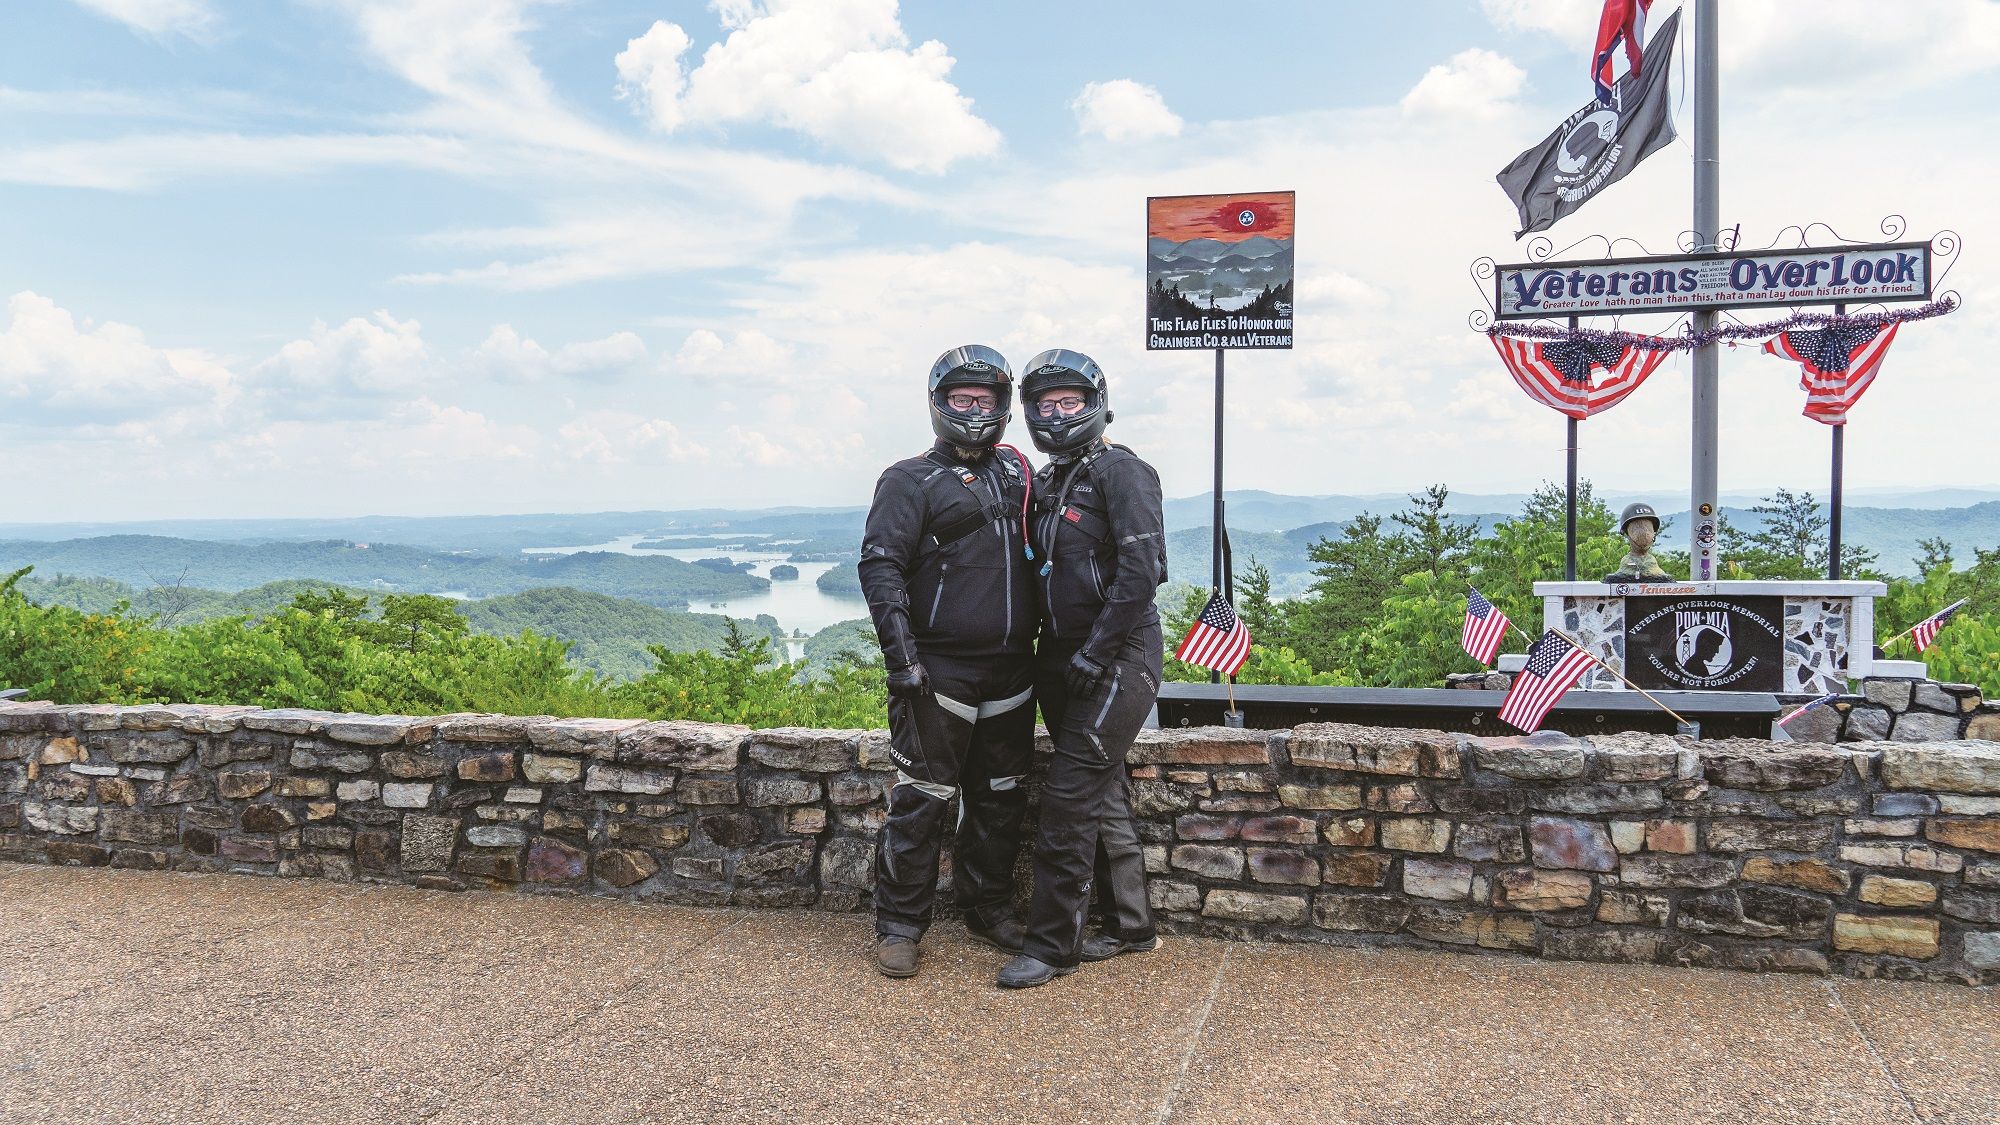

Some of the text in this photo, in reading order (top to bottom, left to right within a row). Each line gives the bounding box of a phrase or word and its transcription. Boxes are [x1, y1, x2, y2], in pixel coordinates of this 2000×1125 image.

[1507, 267, 1700, 312] Veterans
[1542, 300, 1578, 310] Greater
[1579, 299, 1600, 308] Love
[1605, 298, 1626, 306] hath
[1629, 298, 1641, 306] no
[1643, 297, 1663, 305] man
[1667, 294, 1689, 304] than
[1691, 293, 1714, 304] this,
[1715, 290, 1737, 300] that
[1738, 292, 1744, 300] a
[1746, 292, 1767, 300] man
[1789, 287, 1813, 297] down
[1816, 286, 1830, 296] his
[1852, 284, 1869, 294] for
[1880, 284, 1913, 294] friend
[1150, 316, 1292, 332] THIS FLAG FLIES TO HONOR OUR
[1150, 334, 1202, 348] GRAINGER
[1247, 332, 1292, 346] VETERANS
[1639, 583, 1696, 594] Tennessee
[1628, 600, 1780, 638] VETERANS OVERLOOK MEMORIAL
[1675, 611, 1731, 640] POW MIA
[1648, 653, 1759, 687] YOU ARE NOT FORGOTTEN!
